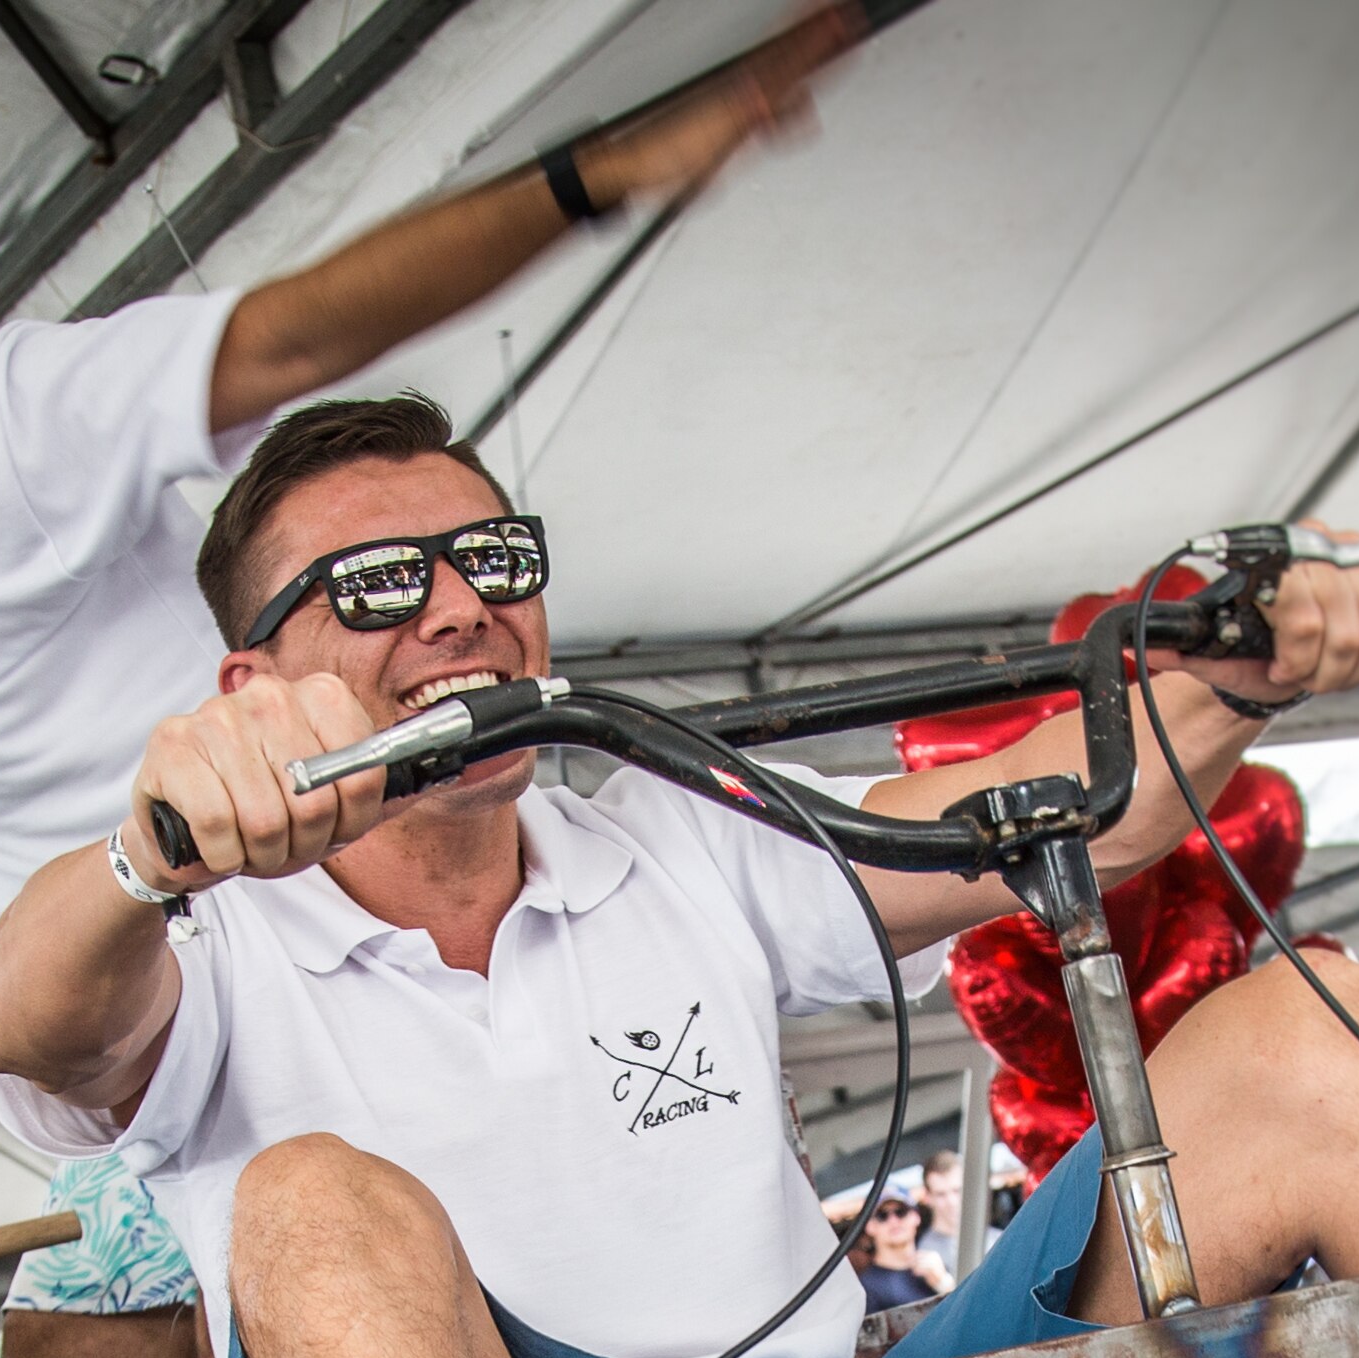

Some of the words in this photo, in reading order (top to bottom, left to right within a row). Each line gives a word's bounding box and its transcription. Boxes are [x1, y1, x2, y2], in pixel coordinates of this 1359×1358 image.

[612, 1070, 632, 1102] C
[694, 1046, 714, 1080] L
[643, 1094, 709, 1130] RACING
